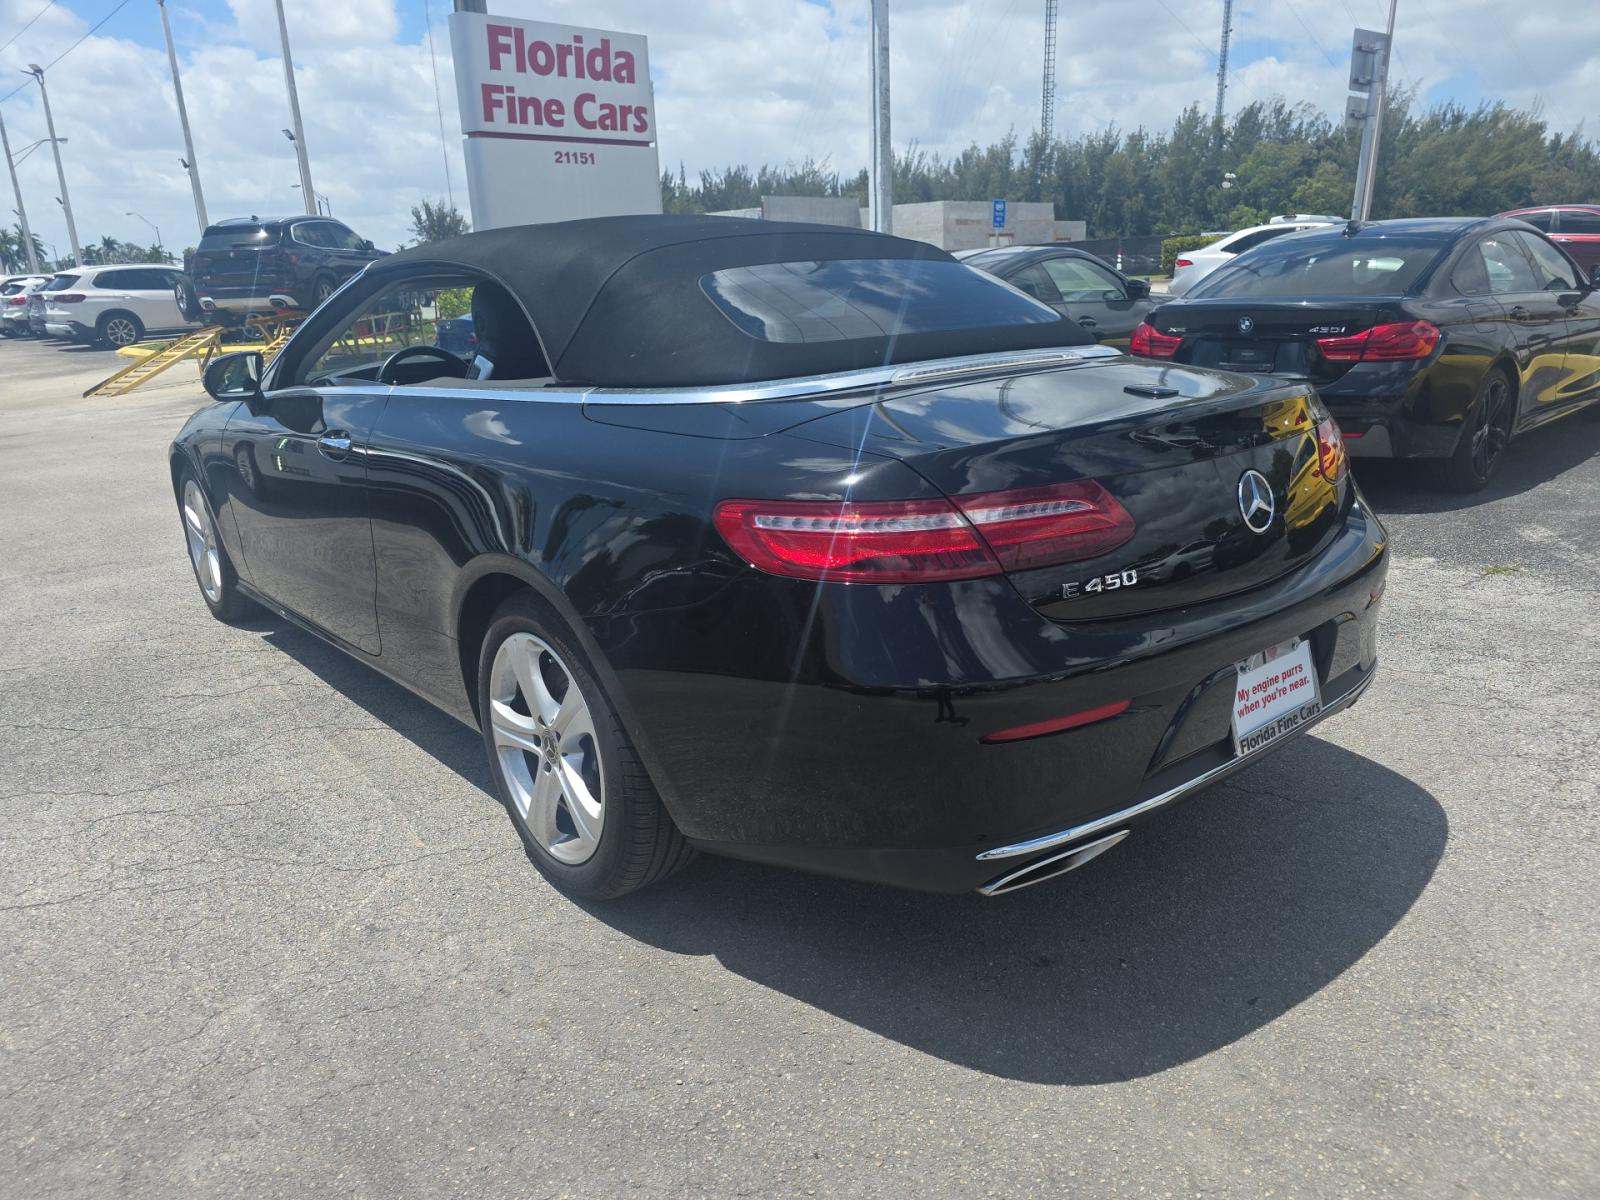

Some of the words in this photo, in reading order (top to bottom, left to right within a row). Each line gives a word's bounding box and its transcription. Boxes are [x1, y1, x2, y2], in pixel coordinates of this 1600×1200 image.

[486, 23, 636, 84] Florida
[481, 82, 565, 128] Fine
[573, 92, 649, 134] Cars
[554, 151, 596, 165] 21151
[1062, 582, 1080, 599] E
[1085, 569, 1138, 592] 450
[1237, 687, 1249, 702] My
[1252, 674, 1280, 695] engine
[1281, 663, 1304, 682] purrs
[1237, 700, 1260, 718] when
[1261, 687, 1288, 708] you're
[1289, 676, 1310, 692] near.
[1240, 726, 1276, 754] Florida
[1278, 714, 1299, 734] Fine
[1300, 702, 1320, 721] Cars
